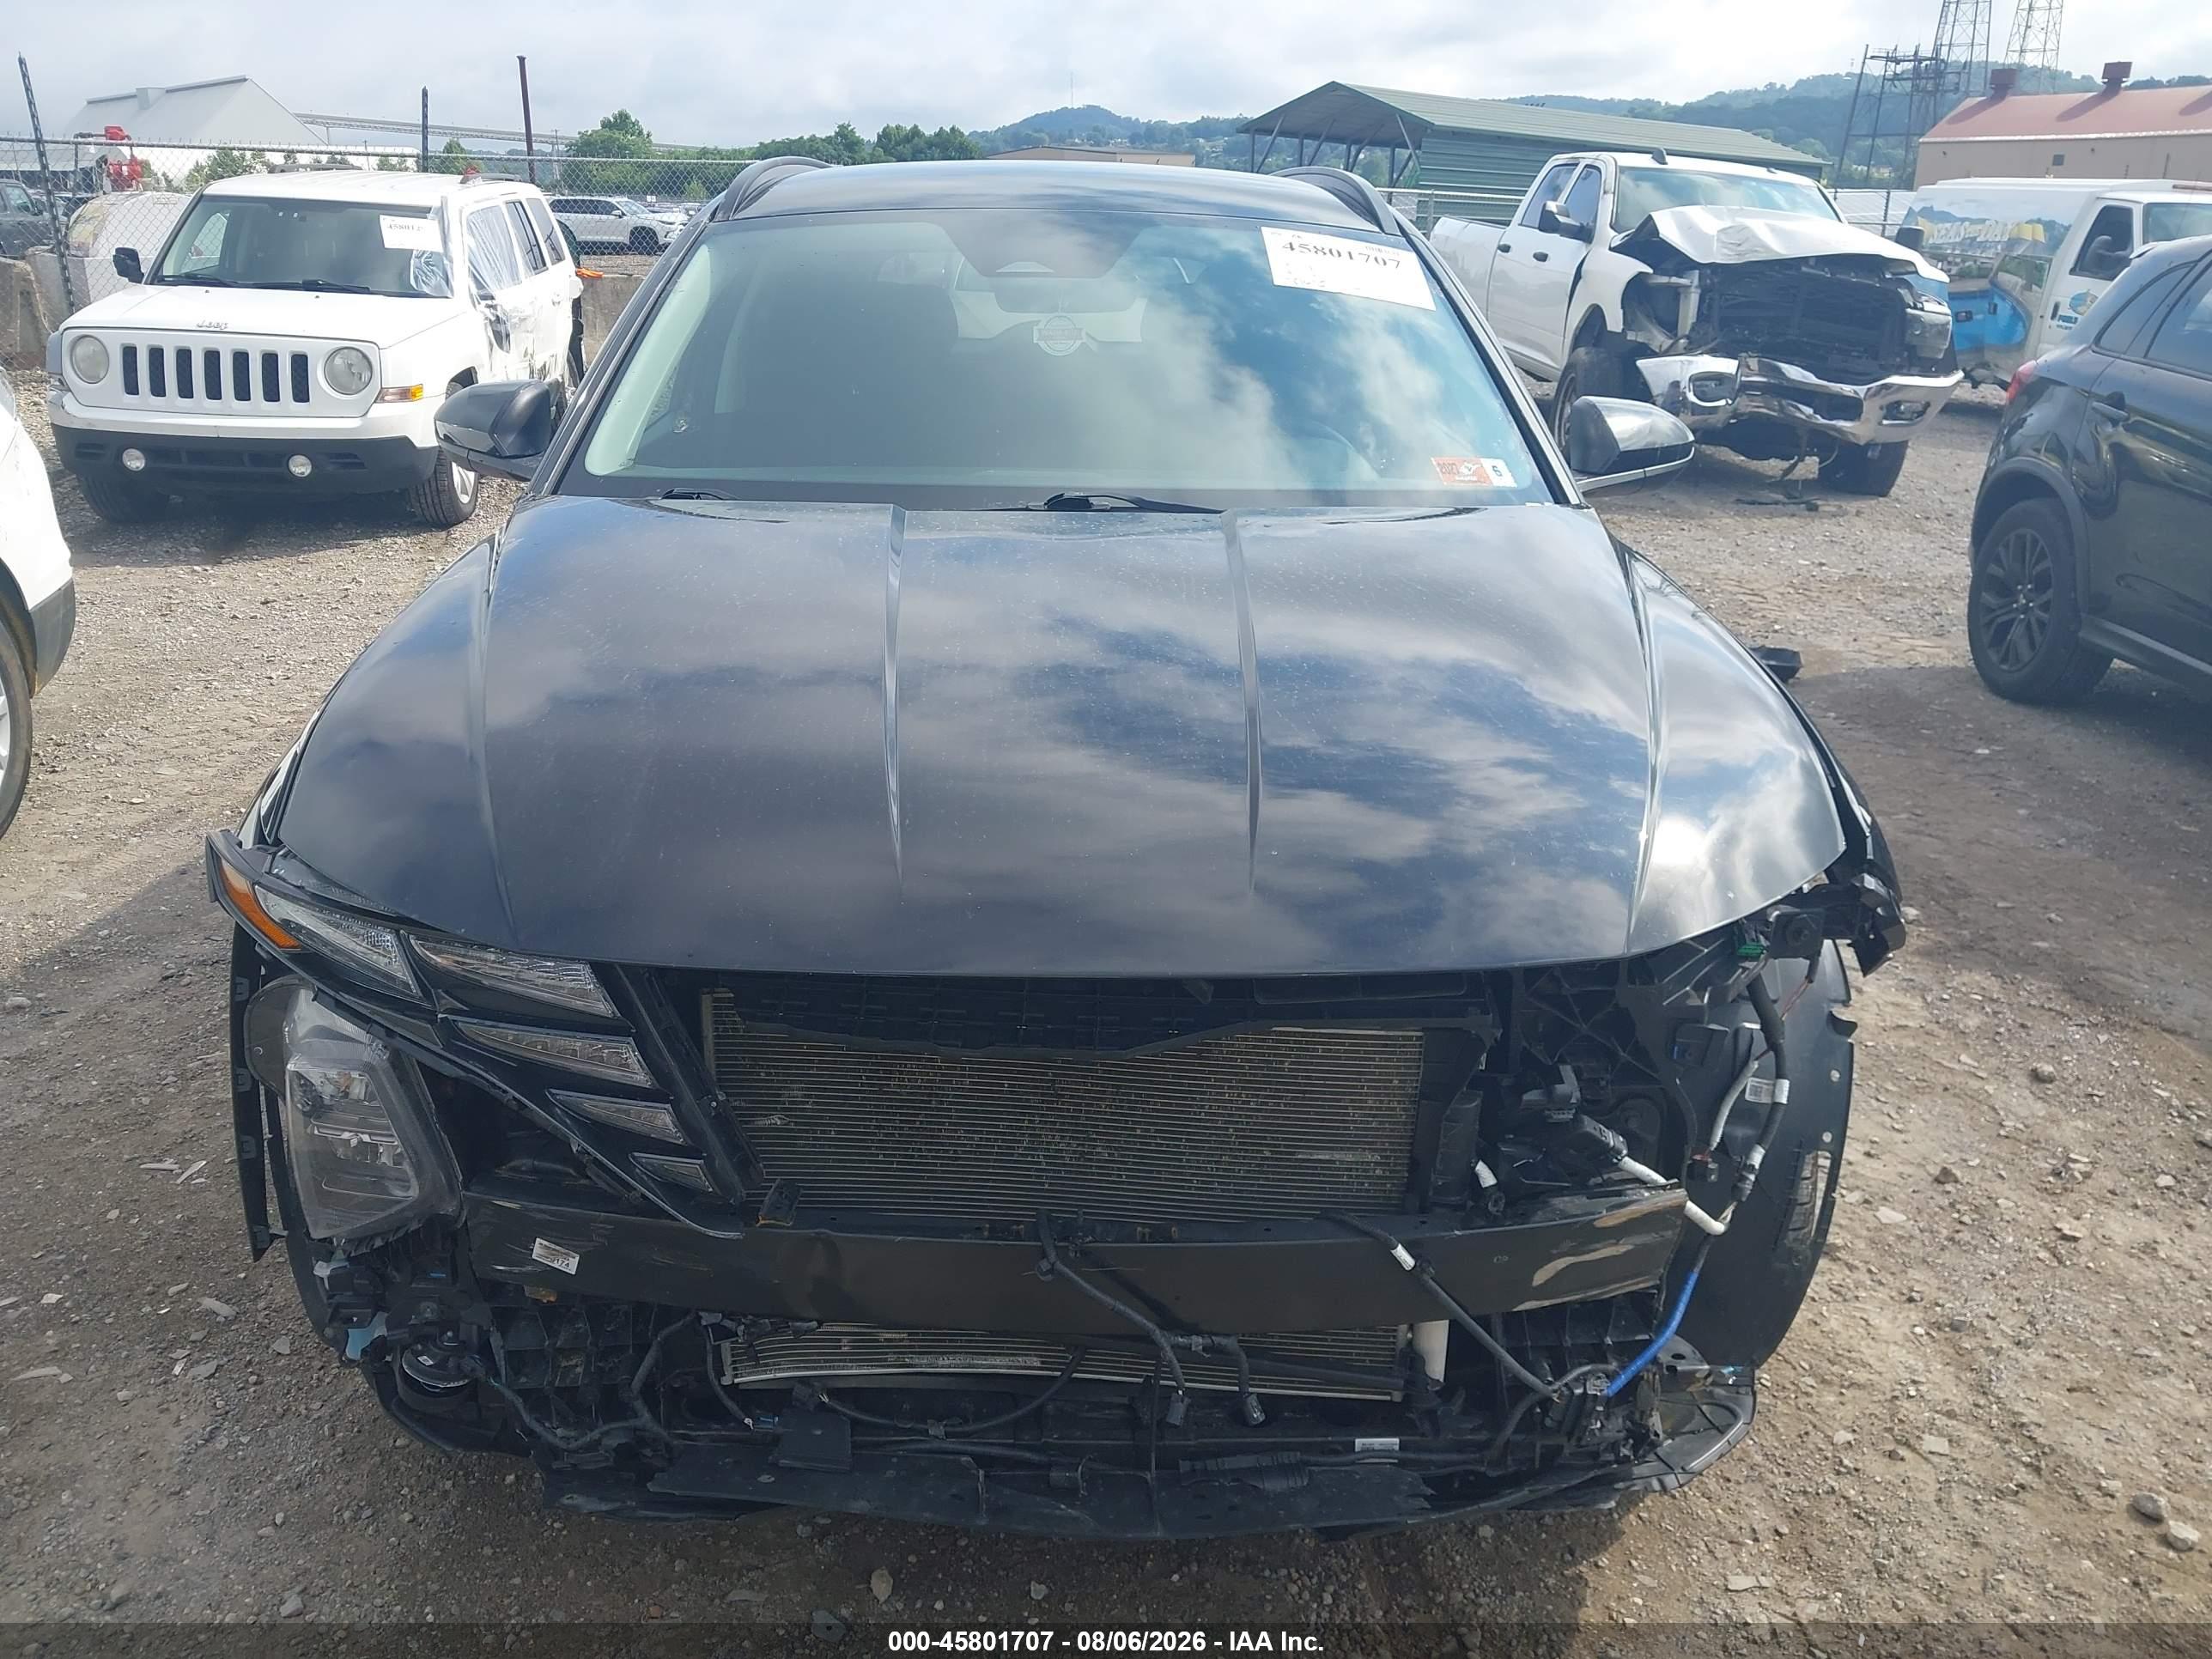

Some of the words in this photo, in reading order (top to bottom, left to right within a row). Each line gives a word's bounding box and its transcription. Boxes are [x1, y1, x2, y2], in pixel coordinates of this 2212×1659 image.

[1282, 241, 1401, 269] 45801707
[196, 319, 228, 330] Jeep
[1492, 465, 1503, 477] 6
